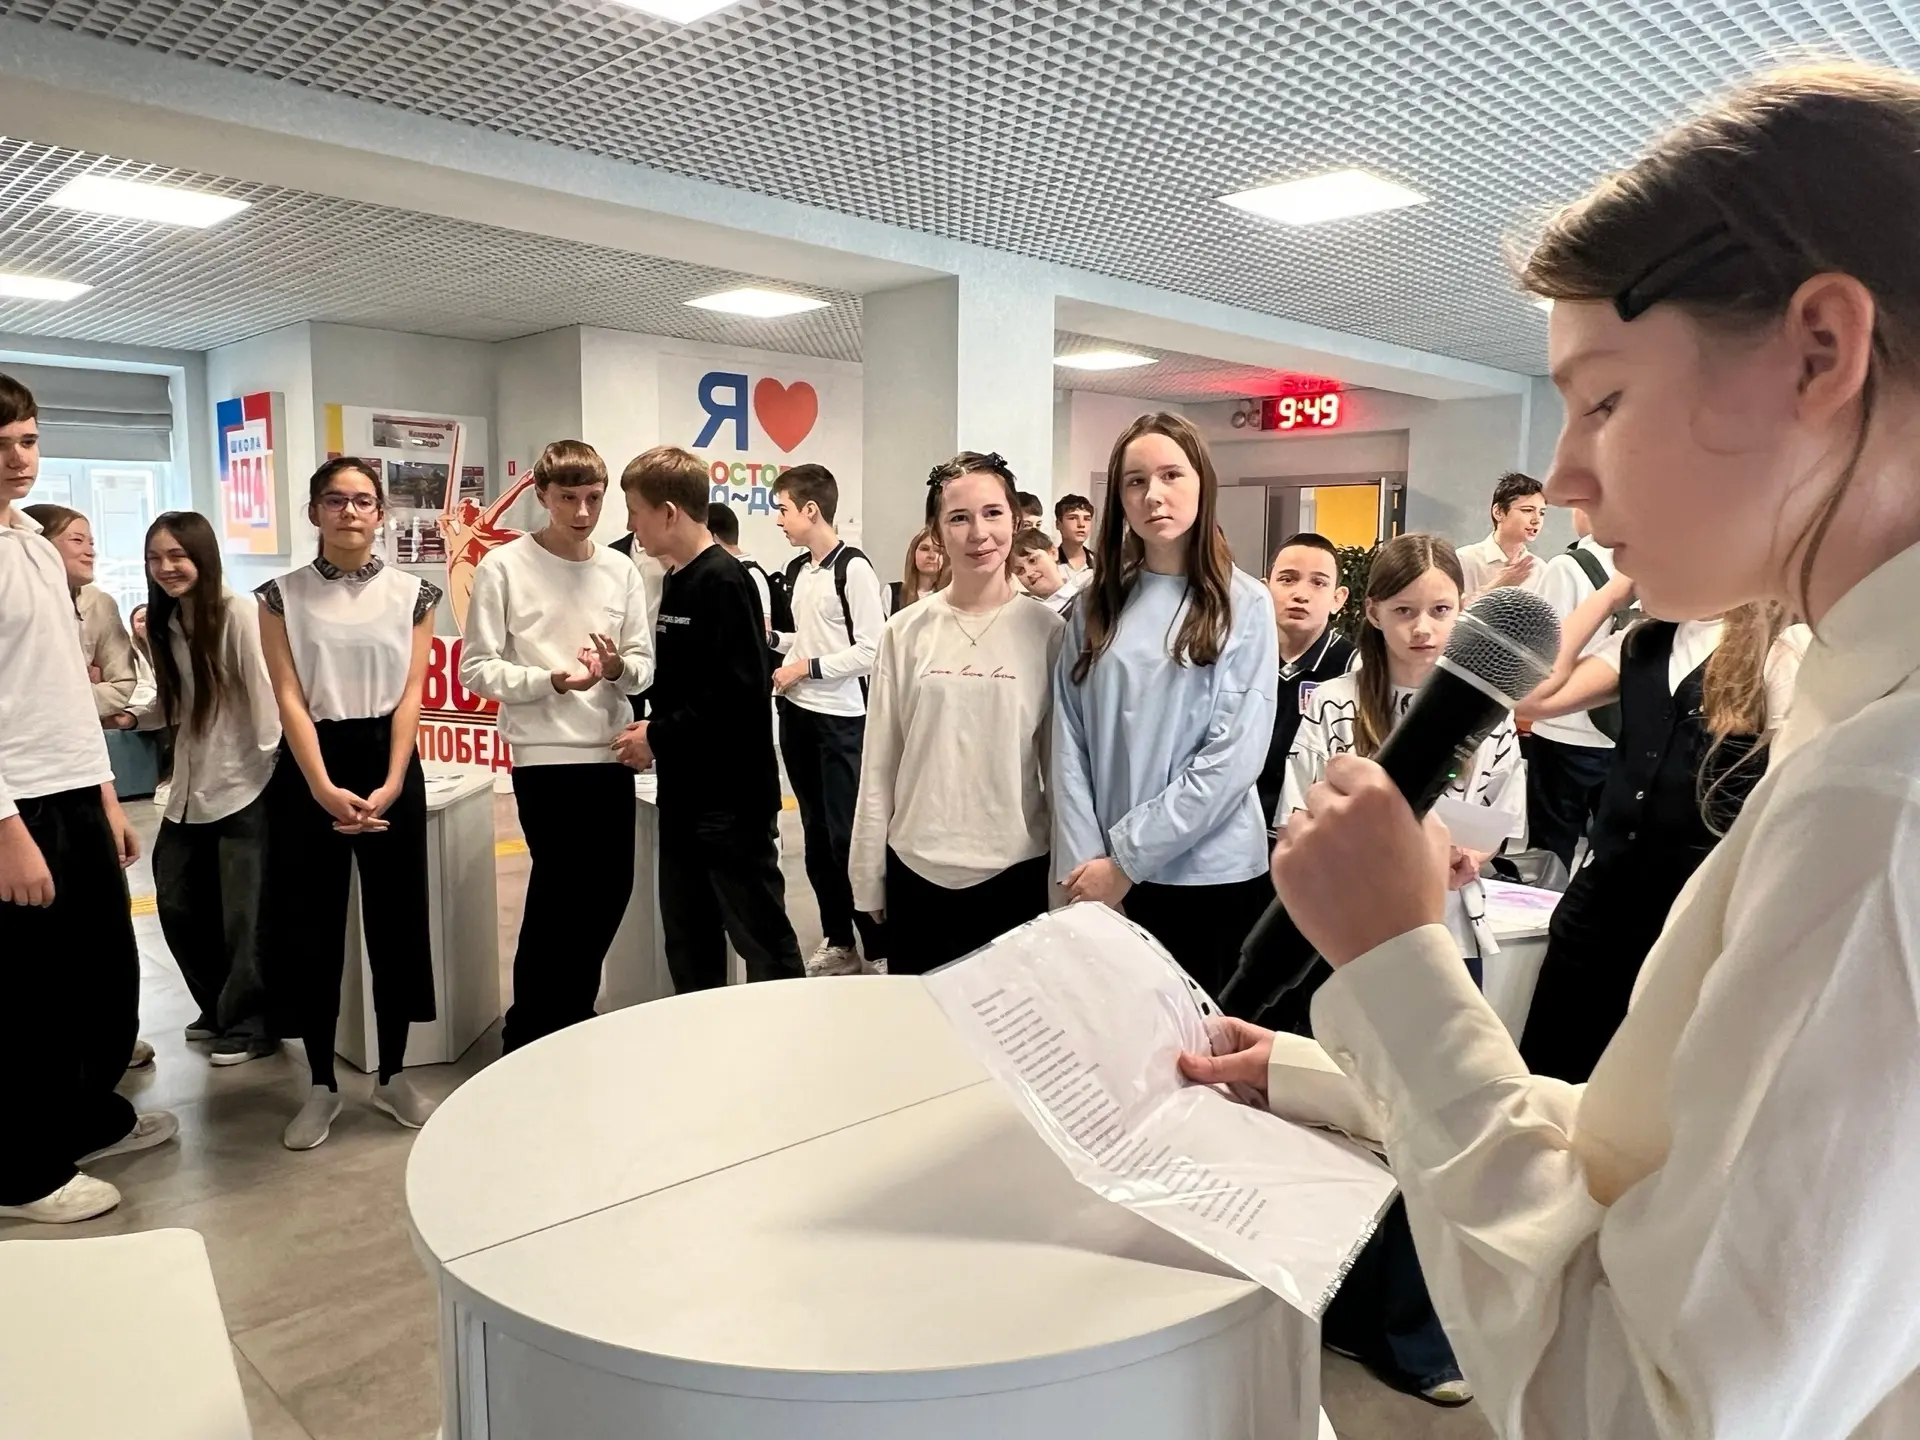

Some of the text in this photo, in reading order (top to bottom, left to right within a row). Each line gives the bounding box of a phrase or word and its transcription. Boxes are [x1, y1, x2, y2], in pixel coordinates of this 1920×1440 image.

[692, 371, 749, 451] Я
[1279, 393, 1339, 429] 9:49
[230, 437, 261, 453] ШКОЛА
[231, 457, 266, 519] 104
[700, 460, 793, 487] ОСТО
[418, 724, 513, 774] ПОБЕД
